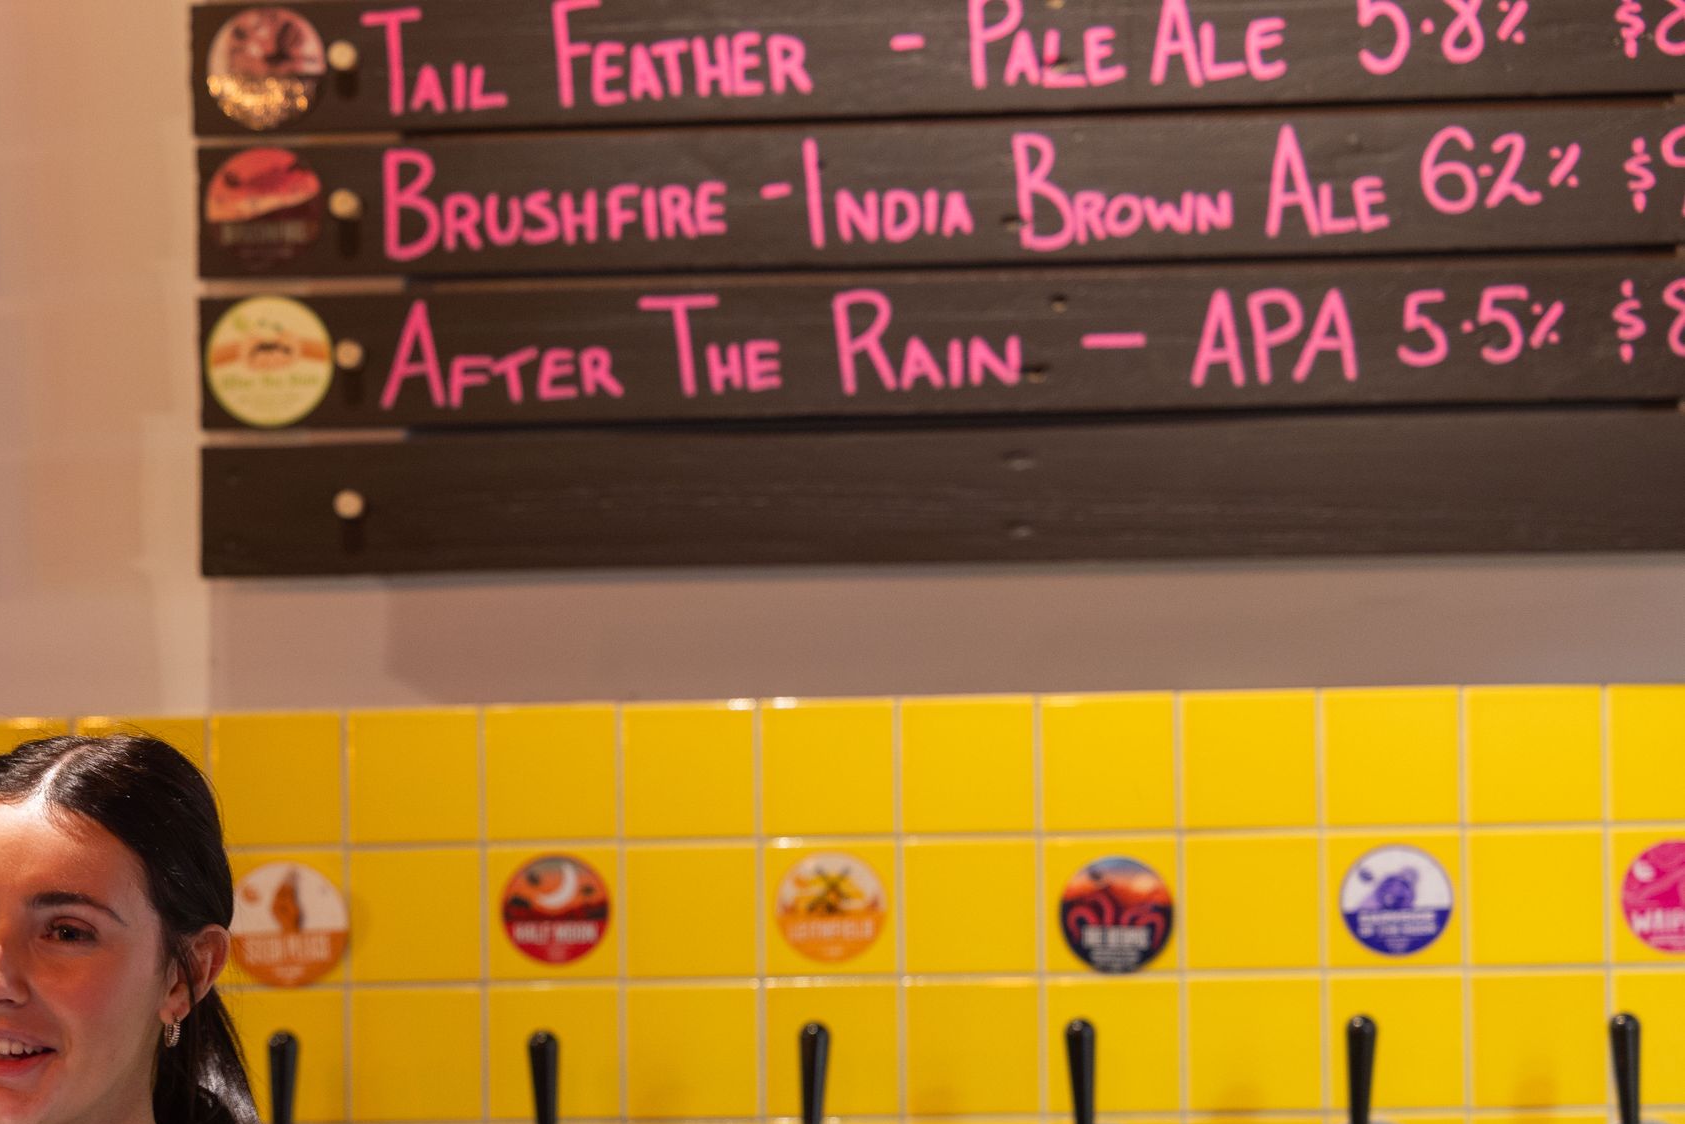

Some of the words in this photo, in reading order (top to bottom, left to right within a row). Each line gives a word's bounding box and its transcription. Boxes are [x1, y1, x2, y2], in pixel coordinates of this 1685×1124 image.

[361, 7, 508, 117] TAIL
[551, 0, 814, 108] FEATHER
[968, 0, 1128, 89] PALE
[1150, 0, 1289, 87] ALE
[382, 147, 729, 262] BRUSHFIRE
[801, 137, 977, 250] INDIA
[1010, 132, 1235, 252] BROWN
[1264, 124, 1392, 239] ALE
[381, 300, 625, 410] AFTER
[638, 293, 783, 399] THE
[832, 288, 1024, 395] RAIN
[1189, 287, 1359, 388] APA
